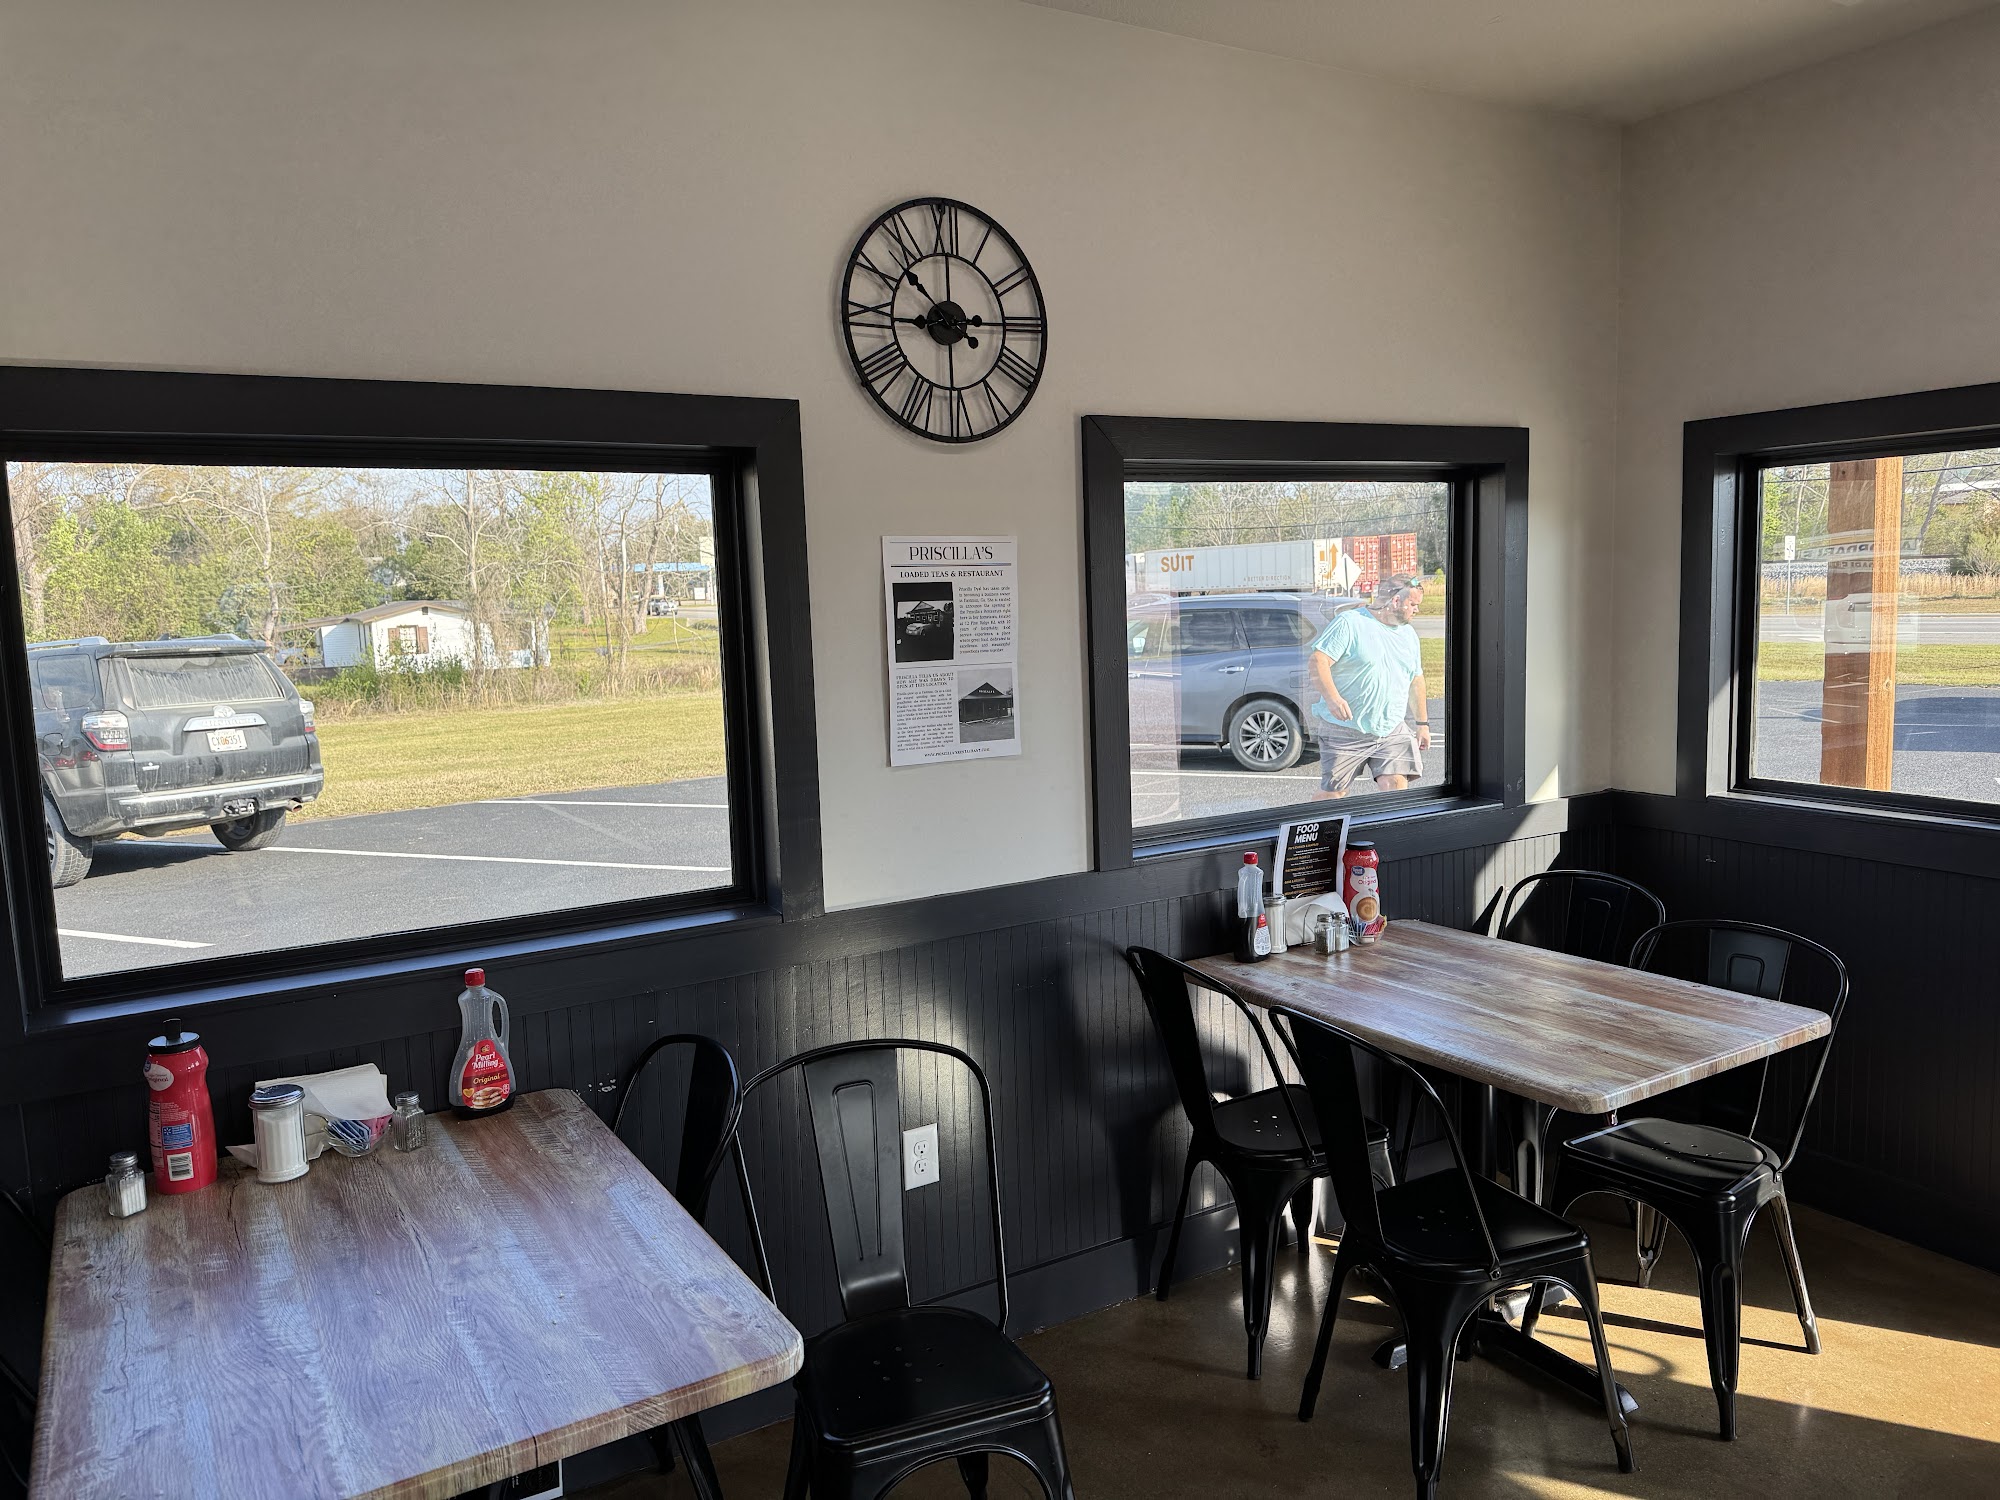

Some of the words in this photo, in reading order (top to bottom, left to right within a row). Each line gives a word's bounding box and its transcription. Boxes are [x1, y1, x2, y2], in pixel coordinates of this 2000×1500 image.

[909, 546, 993, 561] PRISCILLA'S
[1161, 553, 1194, 572] SUIT
[1296, 823, 1320, 834] FOOD
[1294, 832, 1318, 844] MENU
[475, 1051, 495, 1061] Pearl
[472, 1058, 499, 1070] Milling
[473, 1073, 500, 1084] Original
